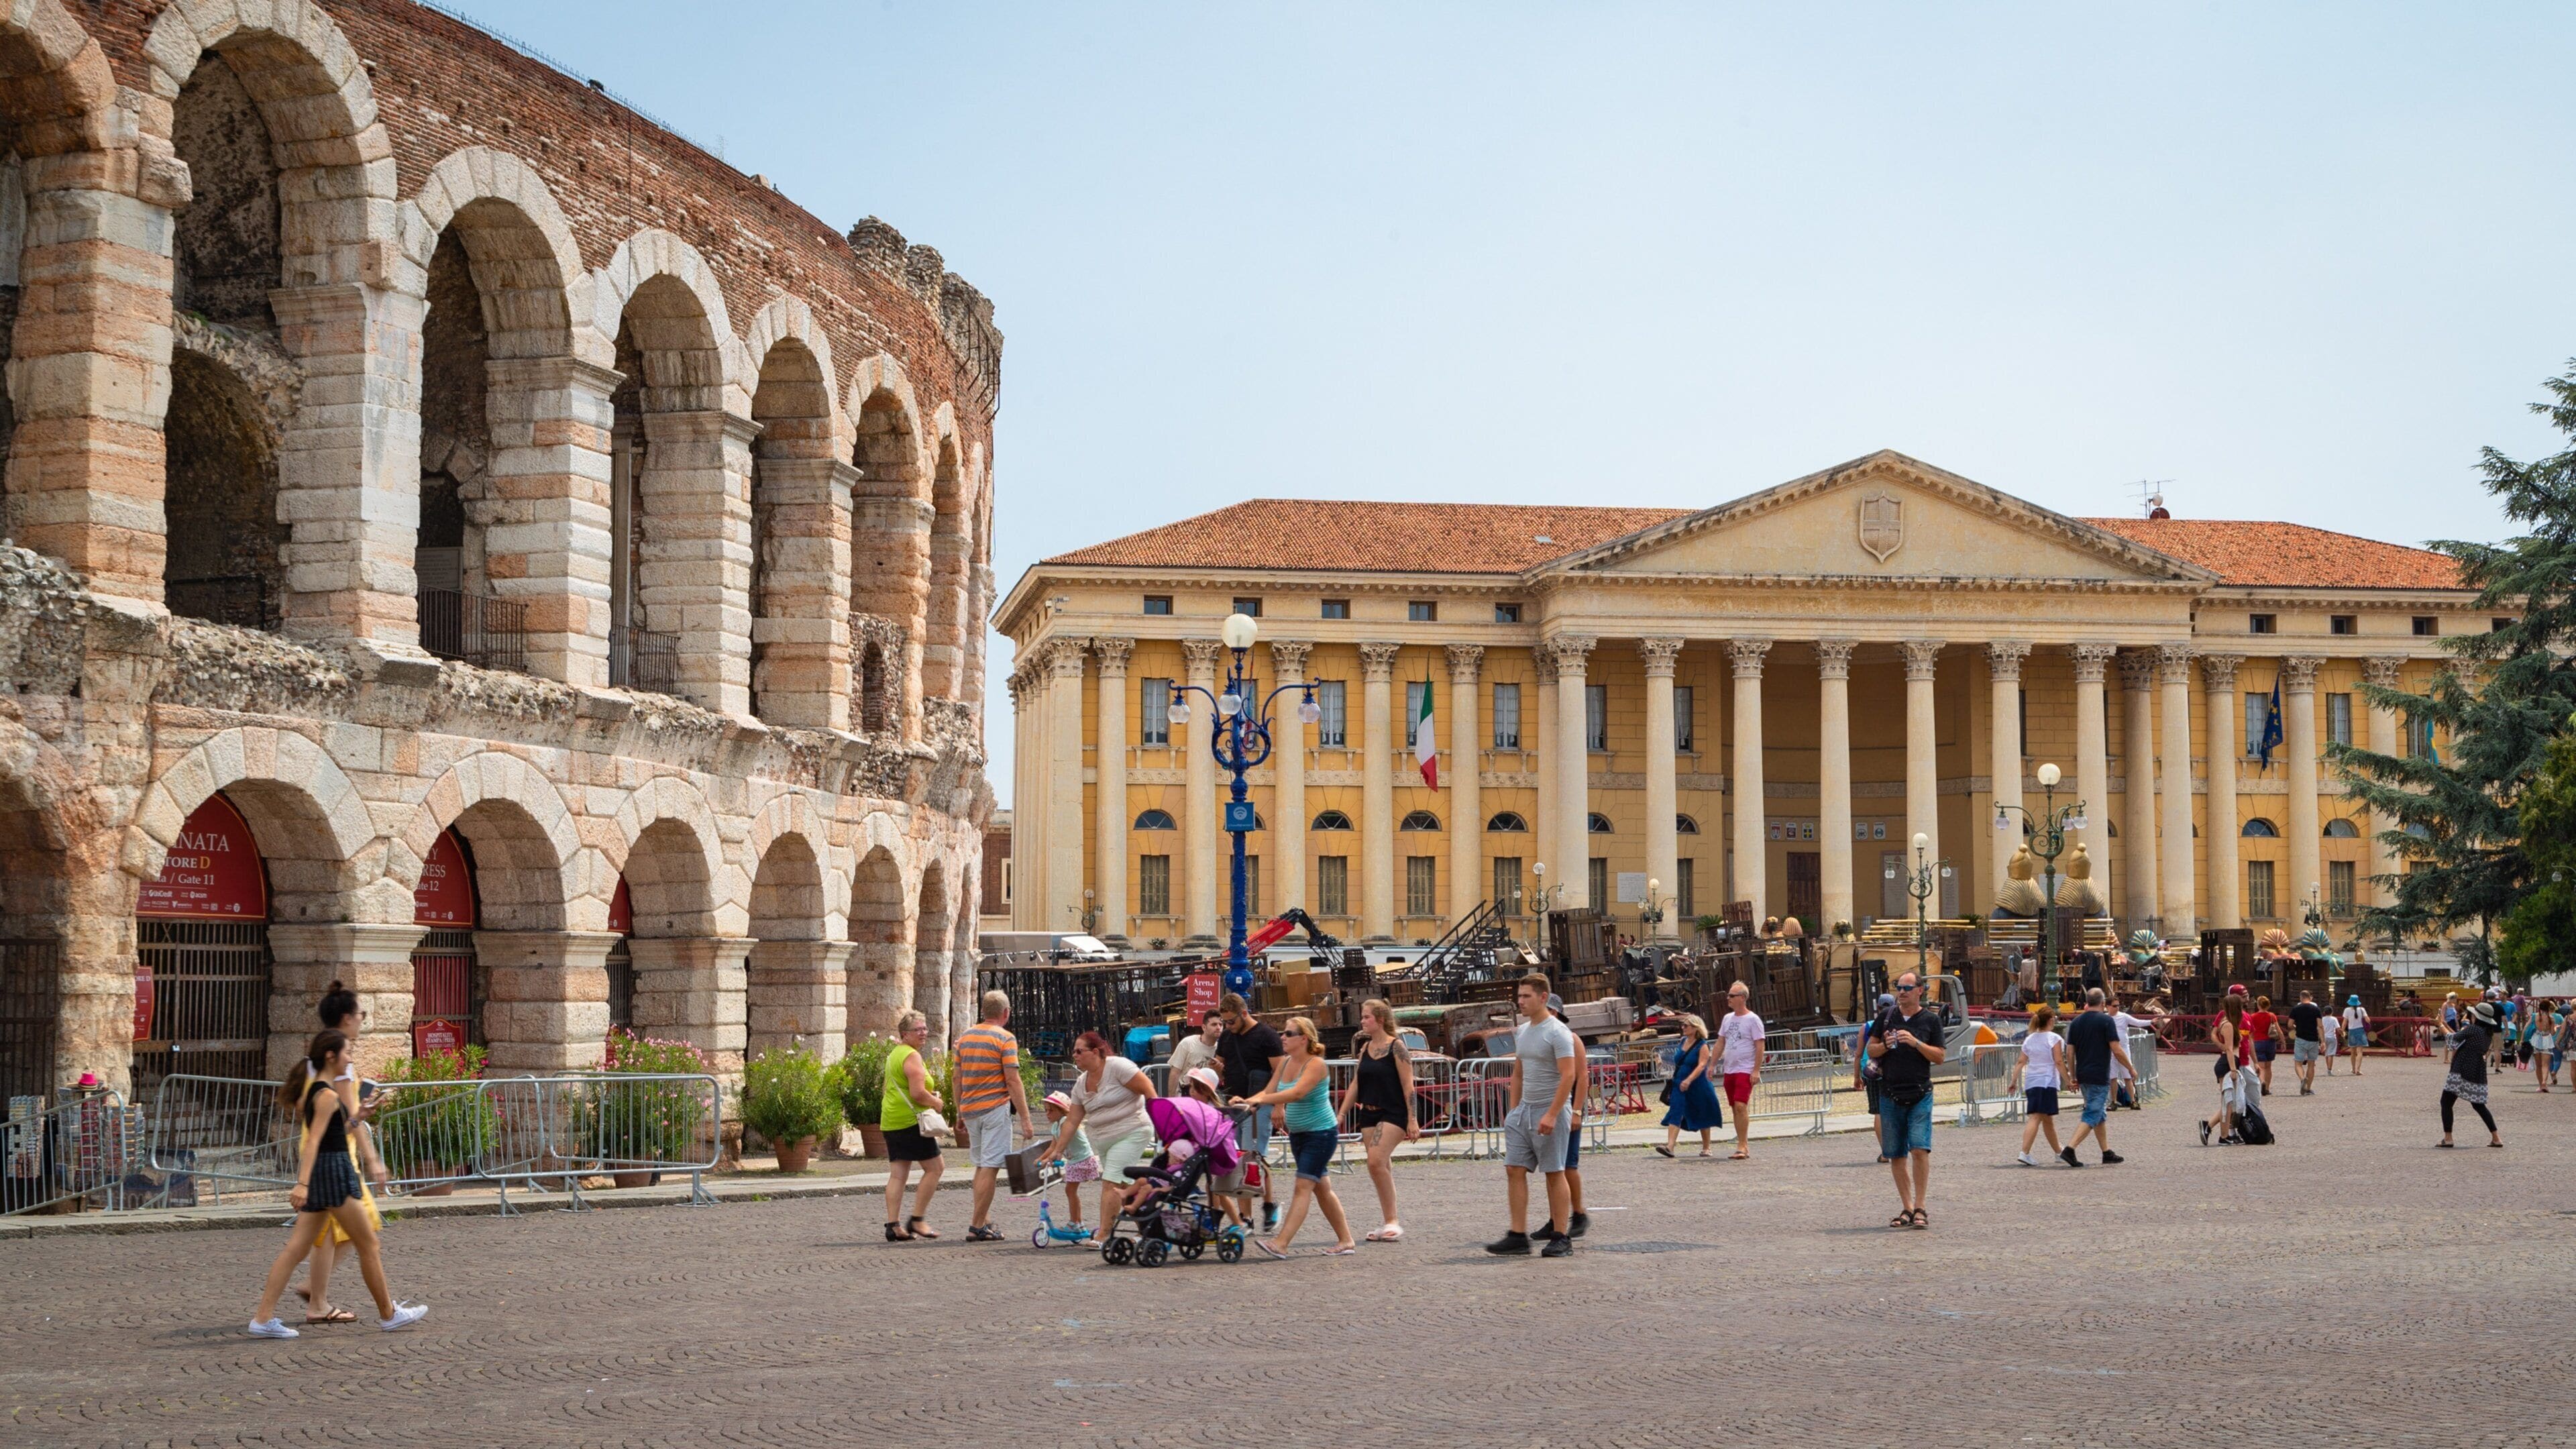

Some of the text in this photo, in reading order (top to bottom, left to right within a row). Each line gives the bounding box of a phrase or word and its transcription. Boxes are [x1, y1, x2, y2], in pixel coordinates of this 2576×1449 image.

[200, 856, 211, 869] D
[178, 874, 201, 884] Gate
[203, 874, 215, 885] 11
[430, 880, 439, 892] 12
[1193, 978, 1215, 987] Arena
[1194, 987, 1213, 998] Shop
[1728, 1022, 1740, 1031] 25
